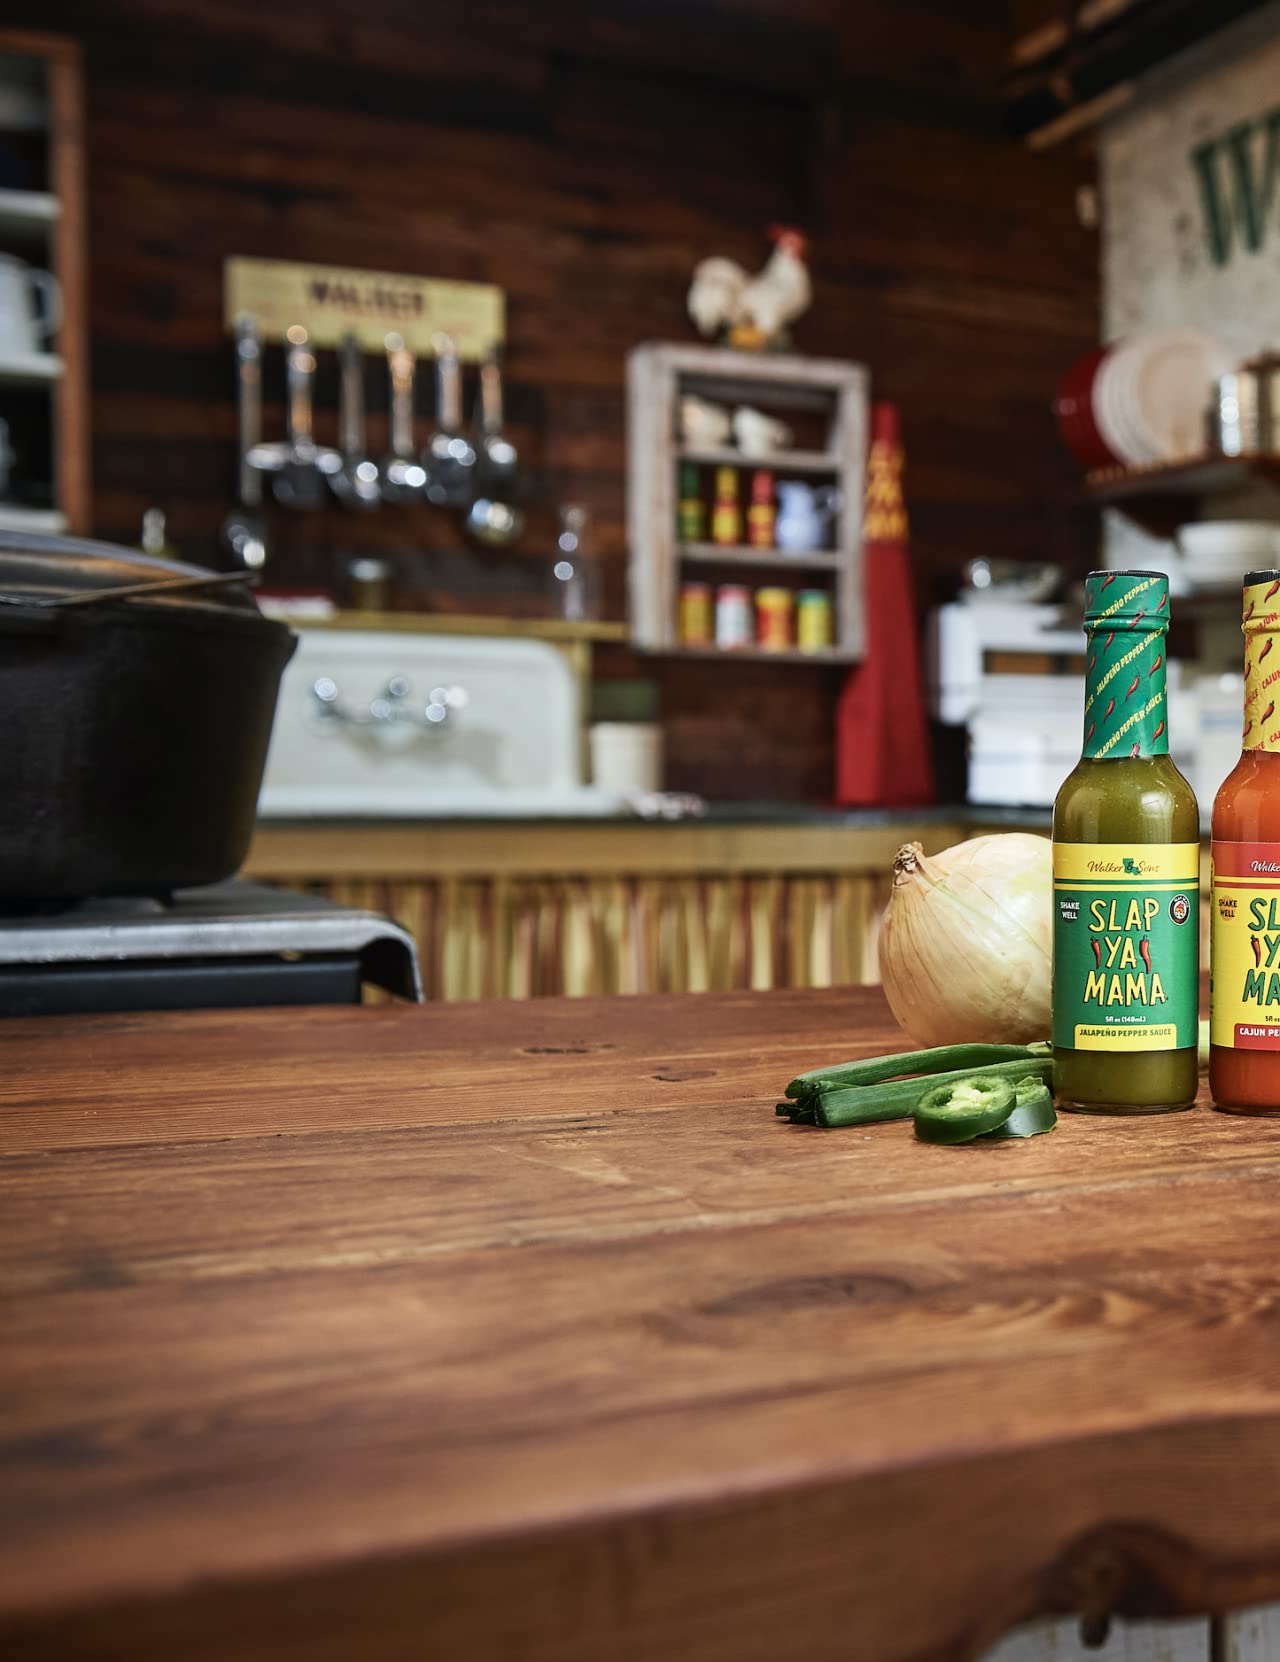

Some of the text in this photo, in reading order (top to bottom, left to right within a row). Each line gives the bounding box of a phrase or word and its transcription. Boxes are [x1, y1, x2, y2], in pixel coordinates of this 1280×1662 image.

[1124, 581, 1149, 603] PEPPER
[1120, 643, 1145, 669] PEPPER
[1120, 710, 1146, 737] PEPPER
[1146, 692, 1163, 714] SAUCE
[1087, 861, 1123, 873] Walker
[1138, 861, 1160, 874] Sons
[1060, 902, 1080, 910] SHAKE
[1219, 899, 1238, 908] SHAKE
[1062, 911, 1078, 919] WELL
[1088, 897, 1160, 932] SLAP
[1220, 909, 1235, 917] WELL
[1104, 935, 1137, 969] YA
[1083, 970, 1166, 1007] MAMA
[1080, 1028, 1116, 1037] JALAPEÑO
[1118, 1029, 1147, 1037] PEPPER
[1240, 1028, 1265, 1036] CAJUN
